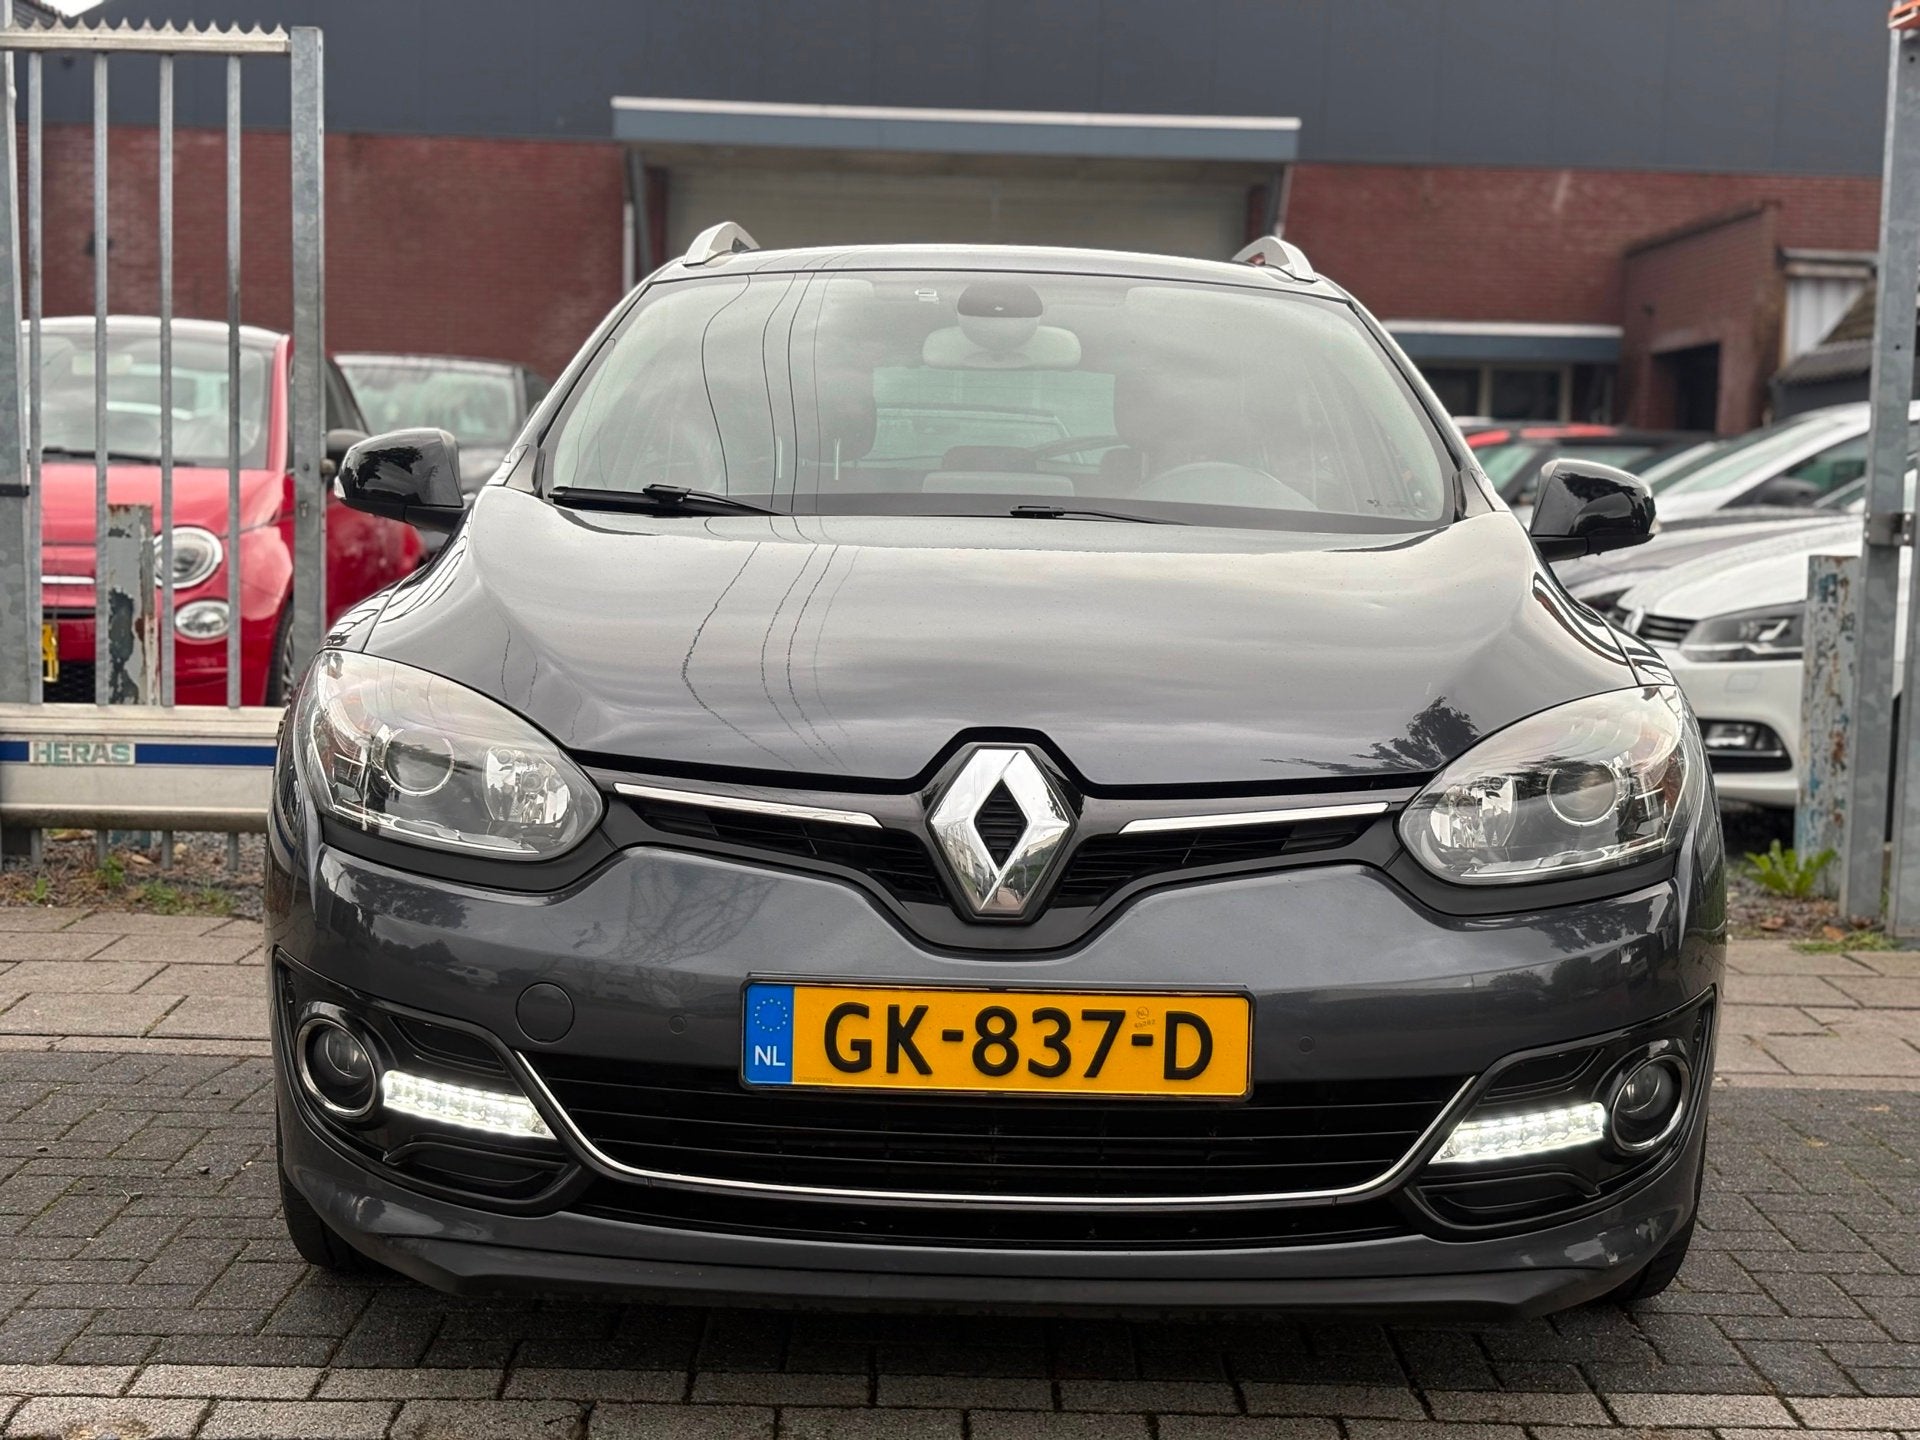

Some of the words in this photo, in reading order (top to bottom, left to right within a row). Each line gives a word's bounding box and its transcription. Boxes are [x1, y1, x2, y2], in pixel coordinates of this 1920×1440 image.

[33, 743, 130, 763] HERAS
[823, 1002, 1213, 1081] GK-837-D
[755, 1045, 786, 1066] NL
